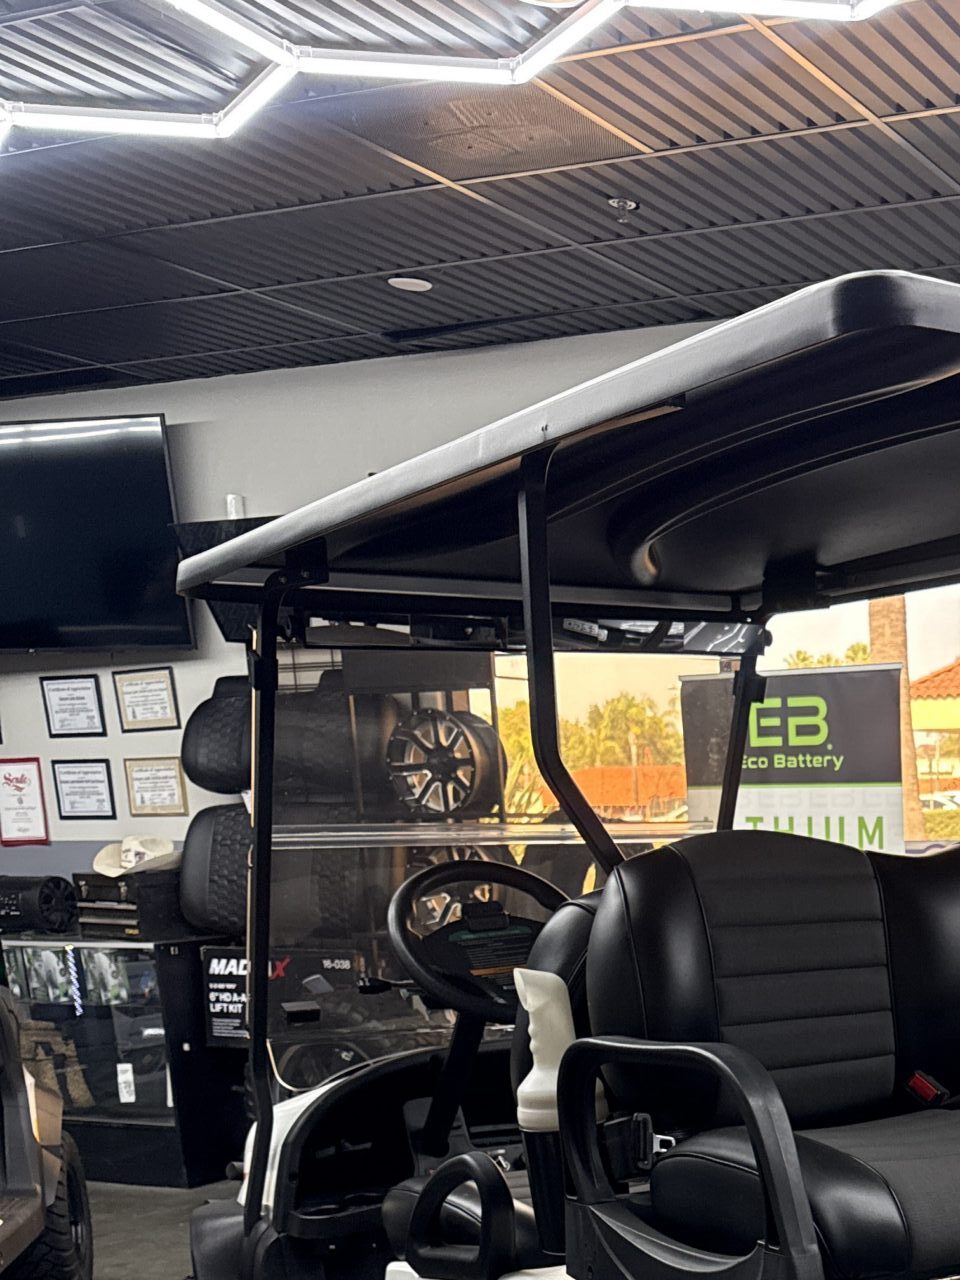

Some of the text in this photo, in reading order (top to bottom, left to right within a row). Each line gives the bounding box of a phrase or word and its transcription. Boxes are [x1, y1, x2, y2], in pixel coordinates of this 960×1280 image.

[749, 696, 829, 748] EB
[773, 753, 844, 771] Battery
[210, 1002, 243, 1014] LIFT KIT
